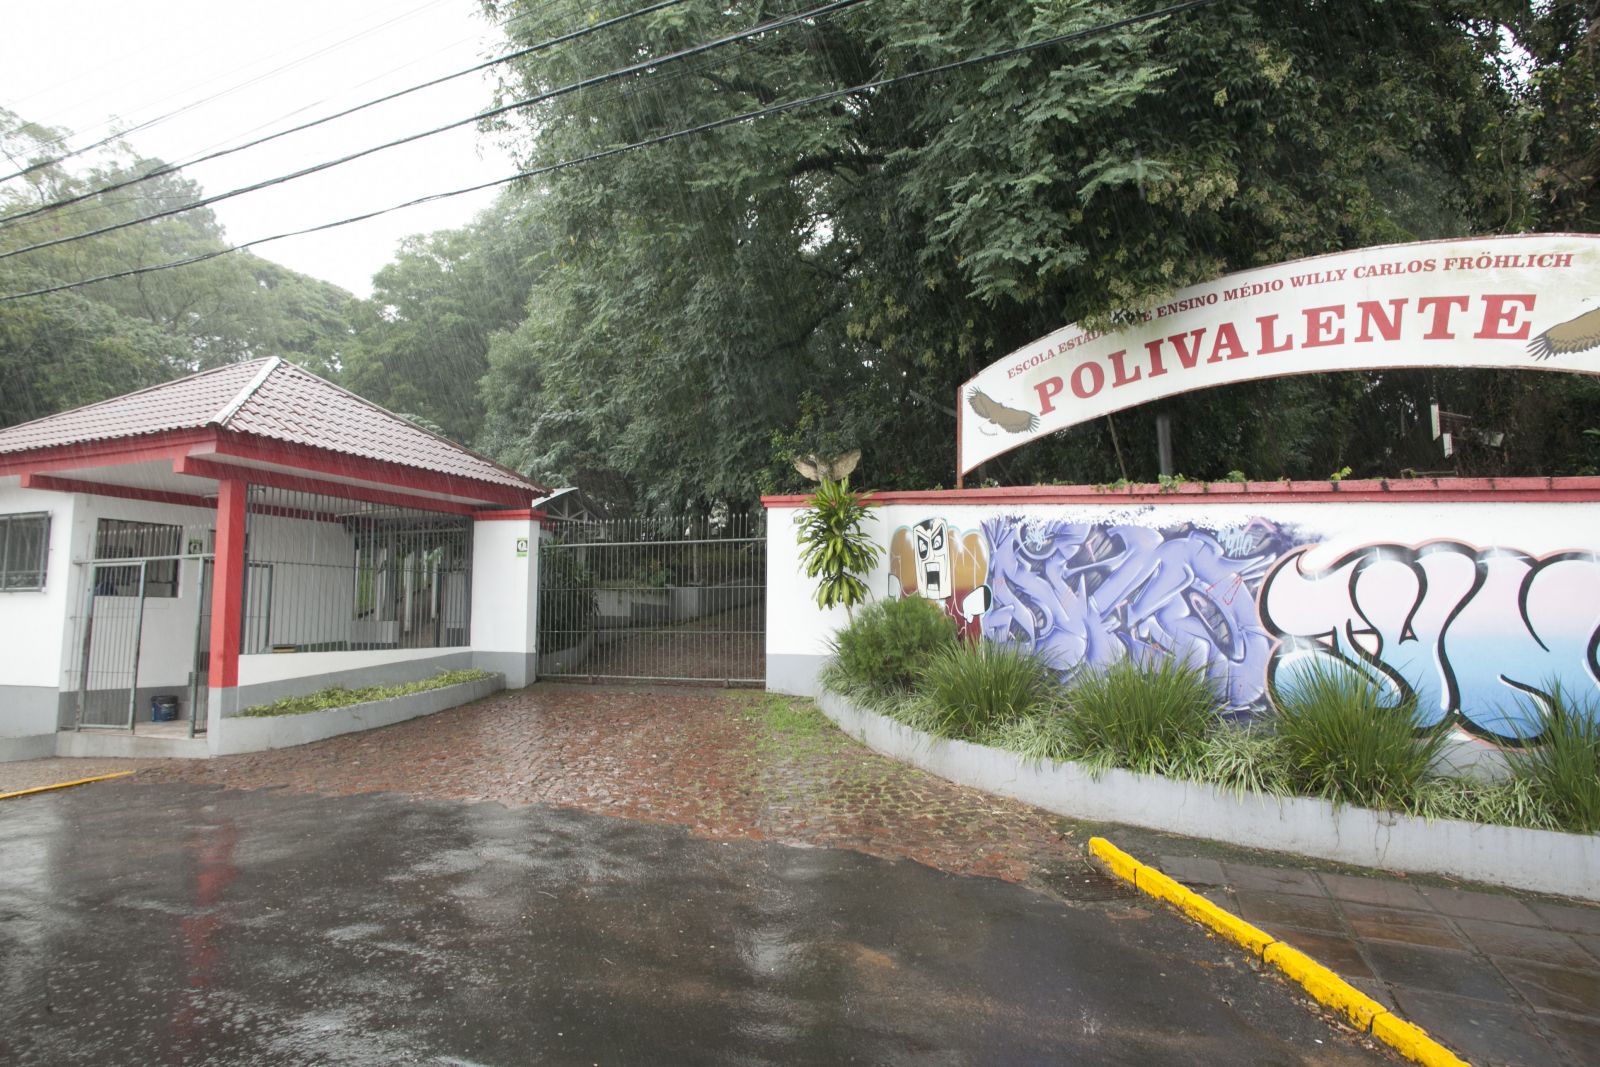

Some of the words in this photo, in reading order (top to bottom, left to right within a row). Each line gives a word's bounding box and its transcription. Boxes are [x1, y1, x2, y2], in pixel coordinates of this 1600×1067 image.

[1007, 349, 1055, 379] ESCOLA
[1156, 293, 1218, 318] ENSINO
[1223, 279, 1284, 302] MÉDIO
[1290, 268, 1347, 288] WILLY
[1353, 258, 1437, 279] CARLOS
[1443, 251, 1574, 271] FRÖHLICH
[1033, 294, 1537, 416] POLIVALENTE
